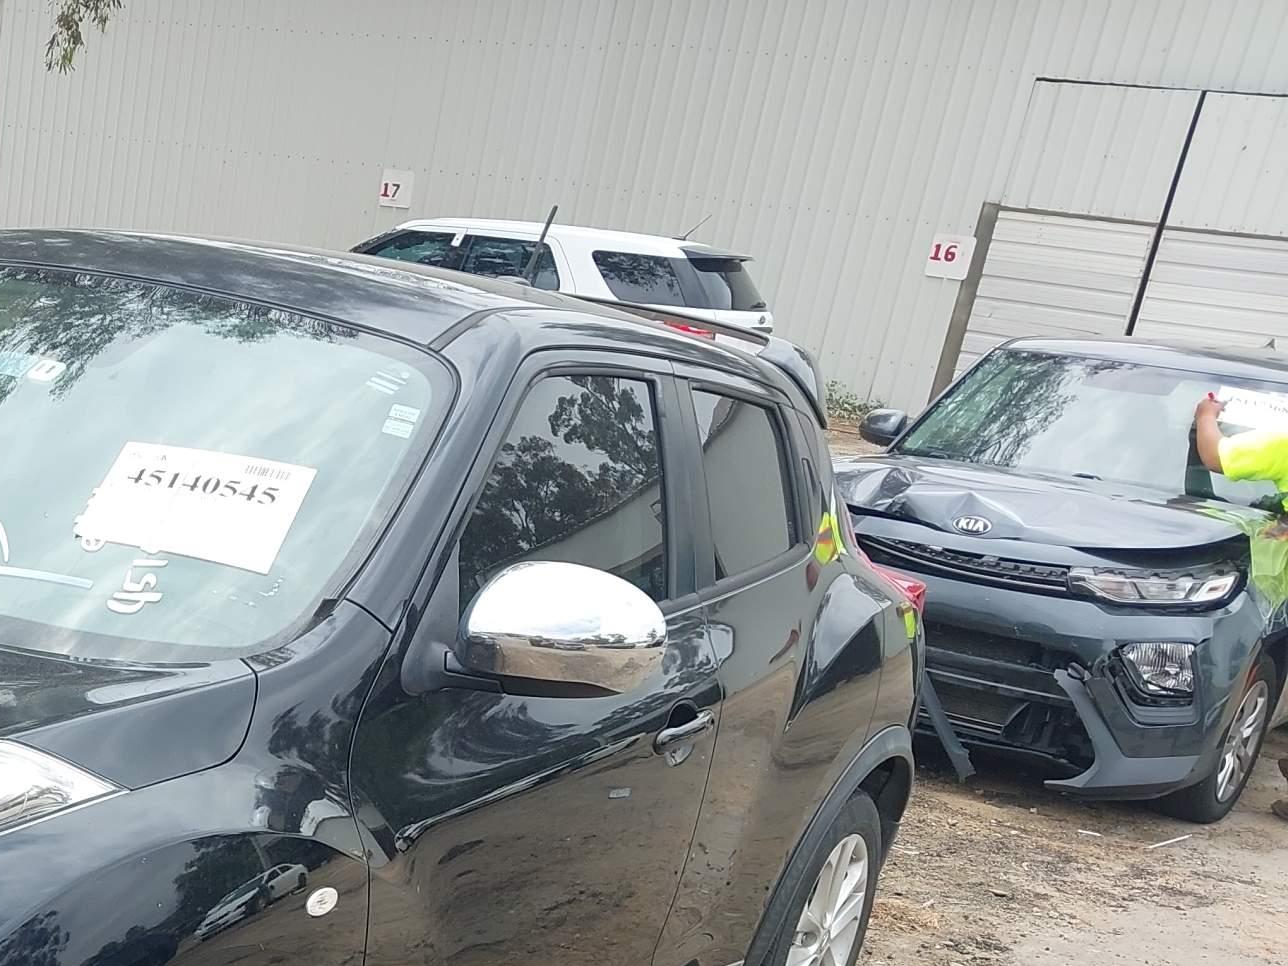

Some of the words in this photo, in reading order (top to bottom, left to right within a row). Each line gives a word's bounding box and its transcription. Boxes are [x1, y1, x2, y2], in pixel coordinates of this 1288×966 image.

[380, 182, 401, 198] 17
[929, 243, 958, 262] 16
[127, 467, 280, 505] 45140545
[958, 517, 984, 532] KIA
